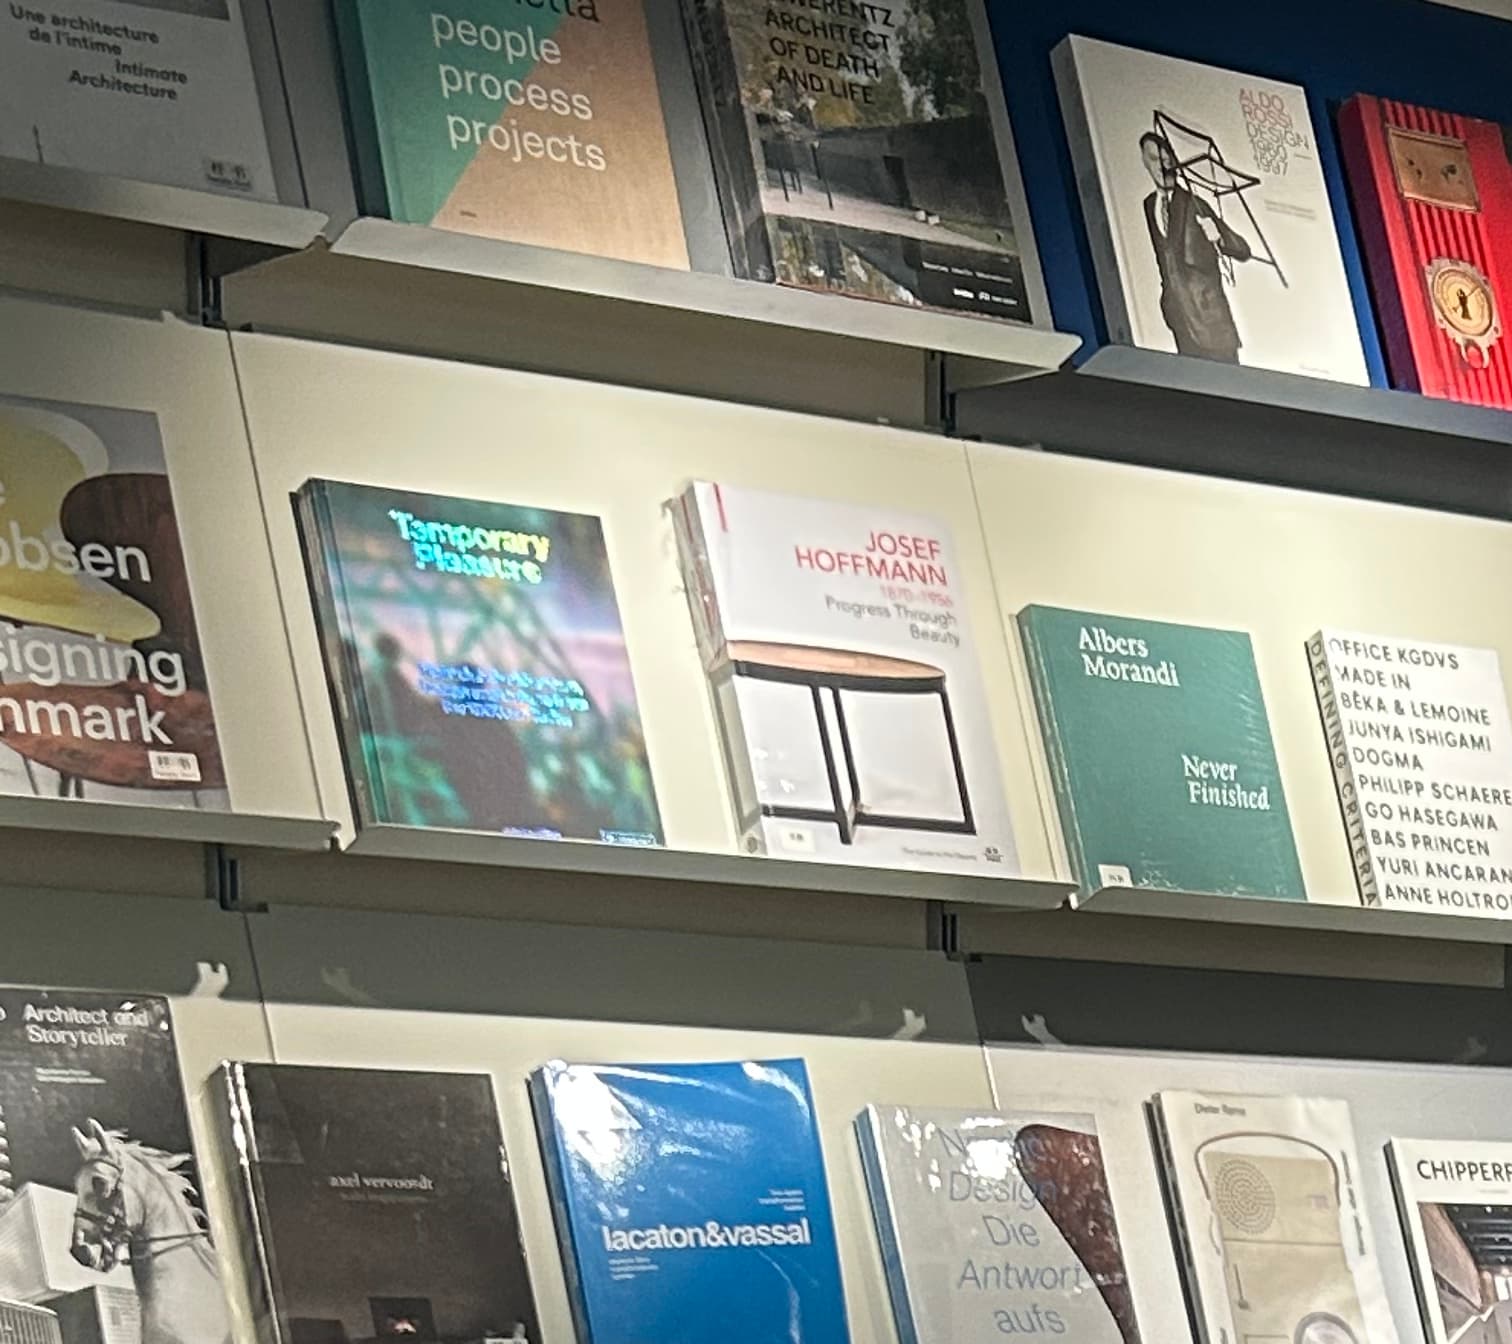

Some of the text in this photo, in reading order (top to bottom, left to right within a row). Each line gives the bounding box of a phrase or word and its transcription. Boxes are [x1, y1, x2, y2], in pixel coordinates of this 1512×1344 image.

[10, 2, 160, 44] Une architecture
[28, 27, 51, 44] de
[431, 13, 562, 65] people
[765, 8, 891, 52] ARCHITECT
[115, 58, 188, 84] Intimate
[769, 36, 880, 78] OF DEATH
[68, 69, 179, 100] Architecture
[439, 63, 593, 121] process
[777, 65, 876, 105] AND LIFE
[1239, 87, 1285, 112] ALDO
[1241, 103, 1294, 130] ROSSI
[447, 114, 607, 172] projects
[1246, 121, 1310, 150] DESIGN
[396, 510, 550, 563] Temporary
[865, 529, 942, 562] JOSEF
[794, 544, 949, 587] HOFFMANN
[824, 593, 958, 630] Progress Through
[909, 622, 961, 649] Beauty
[1078, 626, 1150, 659] Albers
[1328, 636, 1460, 671] OFFICE KGDVS
[1081, 652, 1181, 688] Morandi
[1335, 664, 1412, 691] MADE IN
[1393, 698, 1406, 717] &
[1409, 700, 1492, 727] LEMOINE
[1348, 719, 1492, 753] JUNYA ISHIGAMI
[1180, 752, 1238, 782] Never
[1310, 640, 1378, 907] DEFINING CRITERIA
[1352, 746, 1425, 772] DOGMA
[1187, 779, 1272, 811] Finished
[1358, 773, 1425, 798] PHILIPP
[1364, 801, 1499, 832] GO HASEGAWA
[1371, 828, 1491, 857] BAS PRINCEN
[1376, 855, 1420, 877] YURI
[1384, 883, 1434, 906] ANNE
[22, 1002, 151, 1028] Architect and
[25, 1023, 129, 1048] Storyteller
[949, 1169, 1058, 1211] Design
[601, 1216, 812, 1252] lacaton&vassal
[981, 1214, 1041, 1248] Die
[957, 1257, 1084, 1291] Antwort
[993, 1302, 1067, 1334] aufs
